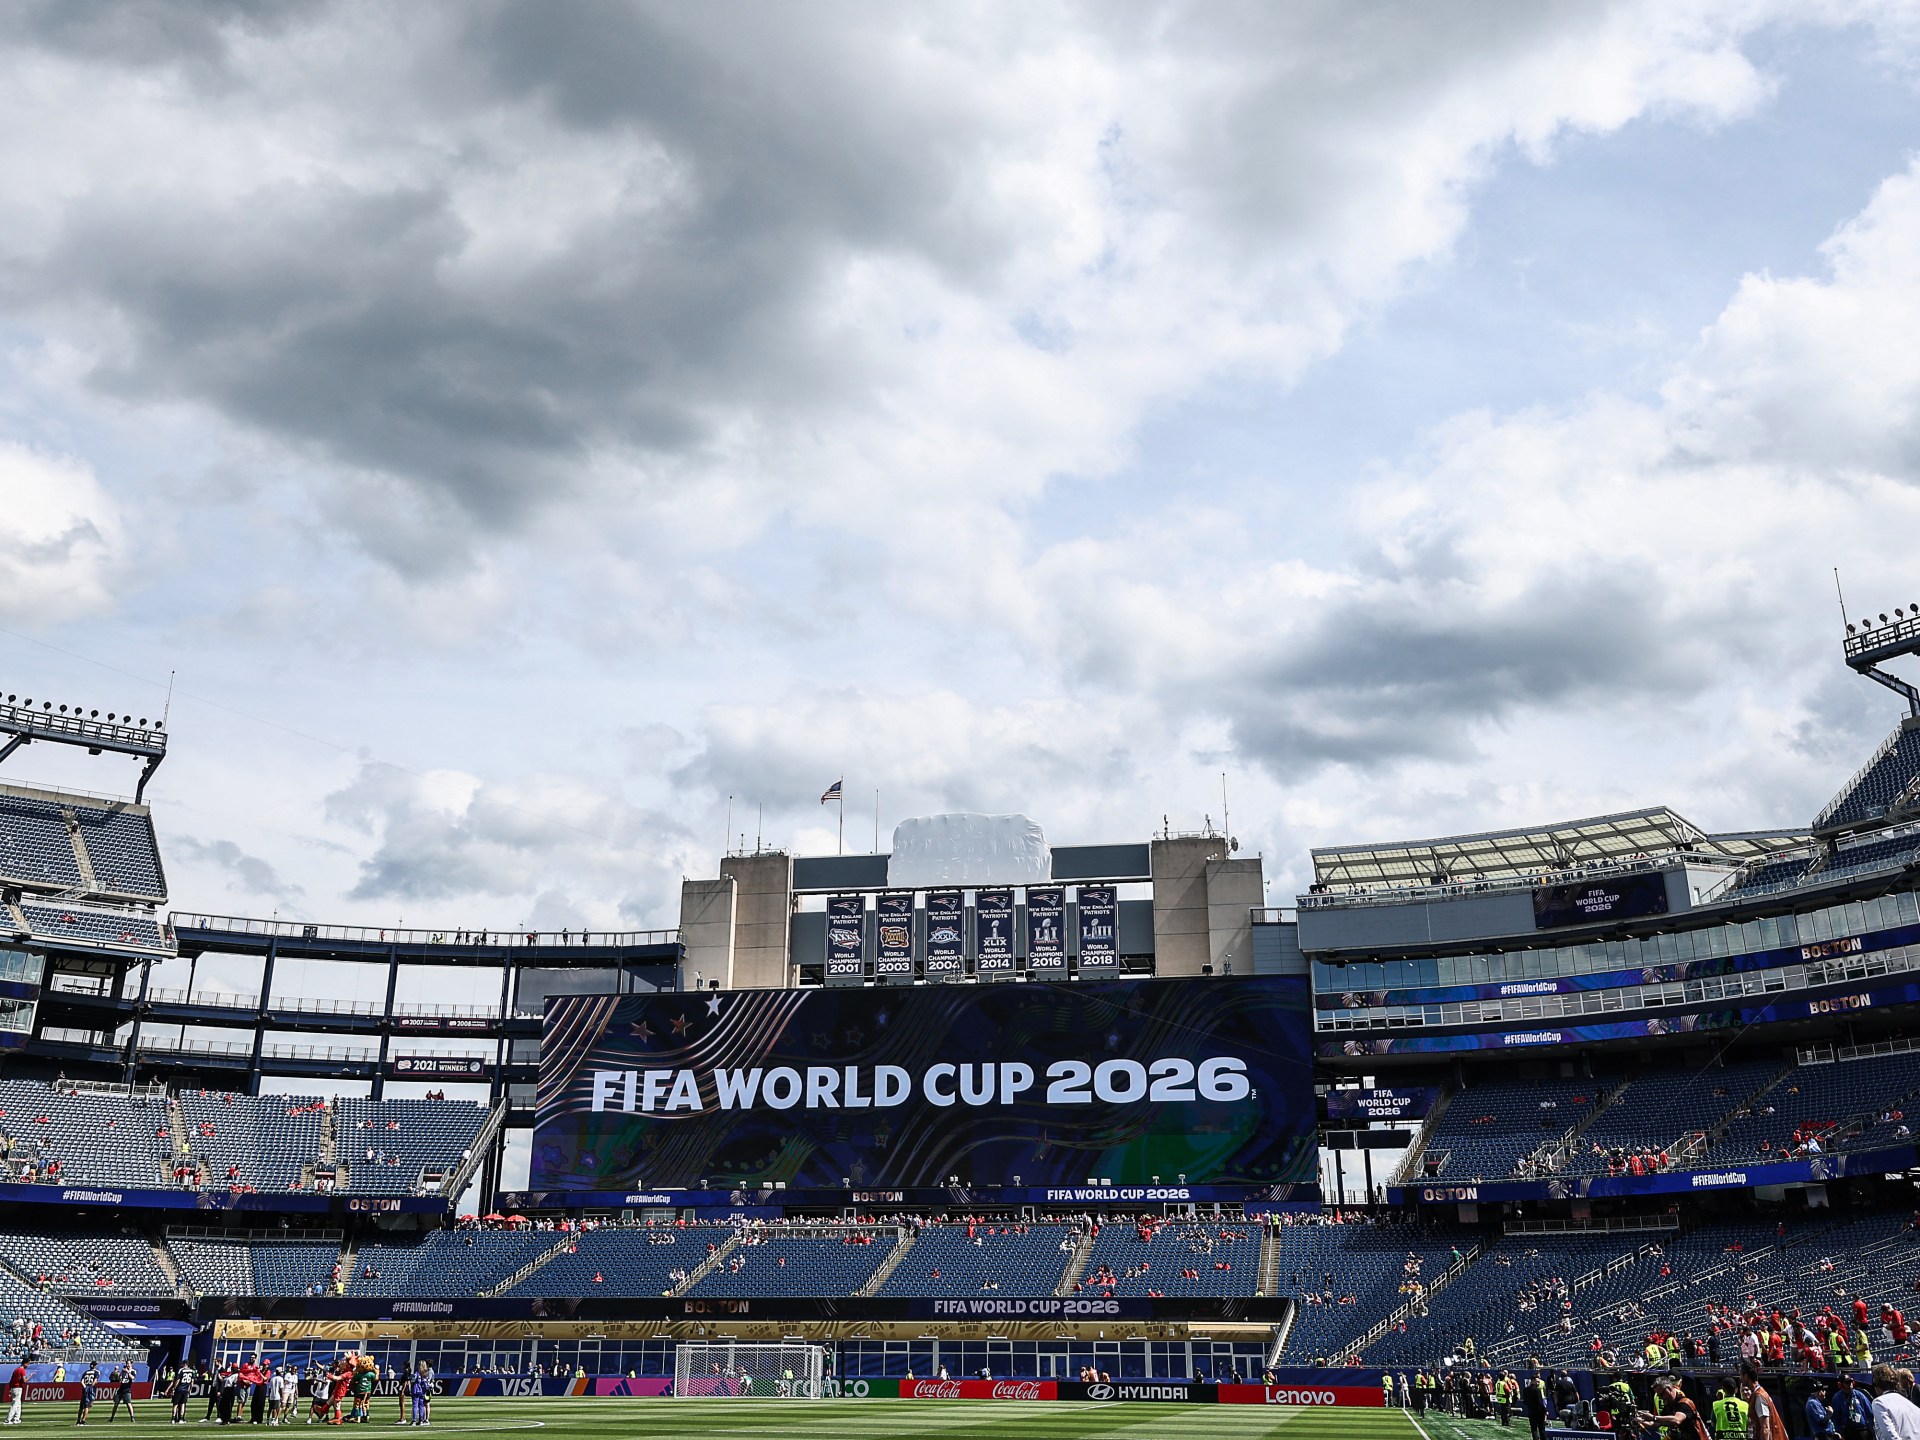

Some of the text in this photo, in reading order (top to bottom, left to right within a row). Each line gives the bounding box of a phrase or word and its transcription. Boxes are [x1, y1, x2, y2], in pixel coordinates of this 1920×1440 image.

[1588, 889, 1605, 897] FIFA
[1576, 894, 1620, 906] WORLD CUP
[1584, 903, 1612, 912] 2026
[1802, 938, 1862, 960] BOSTON
[928, 960, 960, 970] 2004
[980, 958, 1010, 968] 2014
[1032, 957, 1062, 967] 2016
[1084, 956, 1113, 965] 2018
[830, 964, 859, 973] 2001
[878, 962, 910, 972] 2003
[1500, 982, 1558, 994] #FIFAWorldCup
[1809, 994, 1871, 1014] BOSTON
[1504, 1032, 1561, 1044] #FIFAWorldCup
[412, 1060, 437, 1070] 2021
[439, 1064, 468, 1072] WINNERS
[592, 1056, 1250, 1112] FIFA WORLD CUP 2026
[1373, 1089, 1394, 1098] FIFA
[1357, 1098, 1411, 1107] WORLD CUP
[1368, 1107, 1401, 1116] 2026
[1692, 1172, 1746, 1186] #FIFAWorldCup
[62, 1190, 122, 1204] #FIFAWorldCup
[626, 1194, 670, 1204] #FIFAWorldCup
[852, 1191, 903, 1202] BOSTON
[1047, 1188, 1190, 1200] FIFA WORLD CUP 2026
[90, 1304, 116, 1312] WORLD
[392, 1302, 453, 1314] #FIFAWorldCup
[684, 1300, 750, 1313] BOSTON
[934, 1300, 1120, 1314] FIFA WORLD CUP 2026
[181, 1372, 192, 1383] 26
[25, 1384, 65, 1400] Lenovo
[498, 1378, 543, 1396] VISA
[914, 1380, 964, 1398] Coca-Cola
[992, 1380, 1042, 1400] Coca-Cola
[1118, 1386, 1188, 1400] HYUNDAI
[1265, 1386, 1336, 1404] Lenovo
